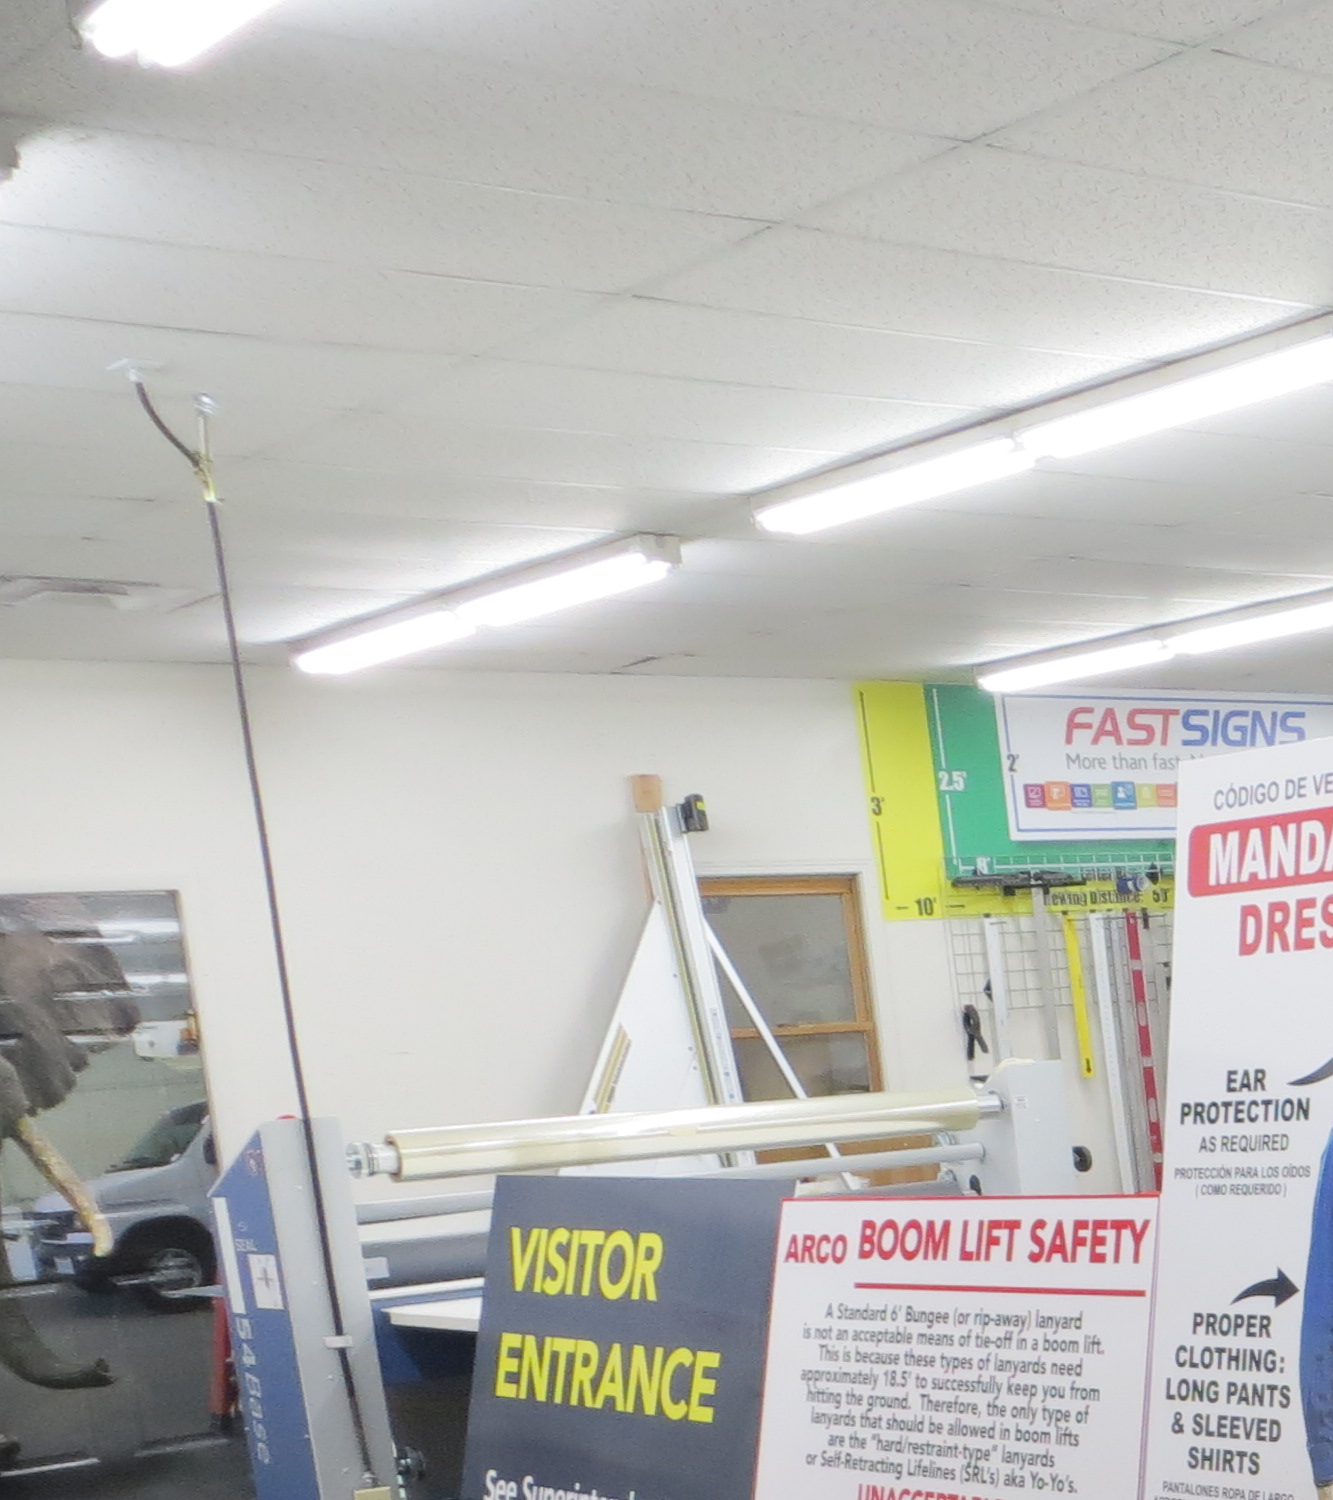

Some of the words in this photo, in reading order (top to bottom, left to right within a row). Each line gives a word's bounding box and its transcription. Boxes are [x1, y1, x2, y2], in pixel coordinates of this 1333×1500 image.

[1064, 706, 1306, 747] FASTSIGNS
[1066, 752, 1107, 771] More
[1112, 752, 1149, 771] than
[1213, 781, 1280, 811] CÓDIGO
[1284, 777, 1308, 801] DE
[1226, 1069, 1268, 1094] EAR
[1179, 1098, 1312, 1126] PROTECTION
[1198, 1136, 1217, 1154] AS
[1220, 1134, 1289, 1153] REQUIRED
[1174, 1164, 1232, 1180] PROTECCIÓN
[1234, 1166, 1259, 1179] PARA
[1261, 1166, 1280, 1179] LOS
[784, 1234, 847, 1264] ARCO
[858, 1219, 951, 1261] BOOM
[959, 1219, 1022, 1262] LIFT
[1027, 1219, 1150, 1264] SAFETY
[510, 1226, 664, 1301] VISITOR
[825, 1303, 834, 1319] A
[837, 1302, 888, 1322] Standard
[905, 1305, 950, 1329] Bungee
[974, 1308, 1032, 1335] rip-away)
[1035, 1310, 1083, 1334] lanyard
[1191, 1311, 1273, 1339] PROPER
[1174, 1344, 1285, 1374] CLOTHING:
[494, 1331, 720, 1424] ENTRANCE
[801, 1366, 879, 1391] approximately
[915, 1374, 928, 1390] to
[931, 1374, 1003, 1398] successfully
[1007, 1375, 1038, 1401] keep
[1042, 1384, 1066, 1403] you
[1070, 1381, 1101, 1402] from
[1165, 1377, 1220, 1404] LONG
[1226, 1381, 1292, 1410] PANTS
[1171, 1411, 1185, 1435] &
[1192, 1412, 1282, 1443] SLEEVED
[806, 1453, 817, 1466] or
[821, 1450, 903, 1480] Self-Retracting
[907, 1458, 956, 1481] Lifelines
[1003, 1468, 1025, 1488] aka
[1187, 1445, 1261, 1476] SHIRTS
